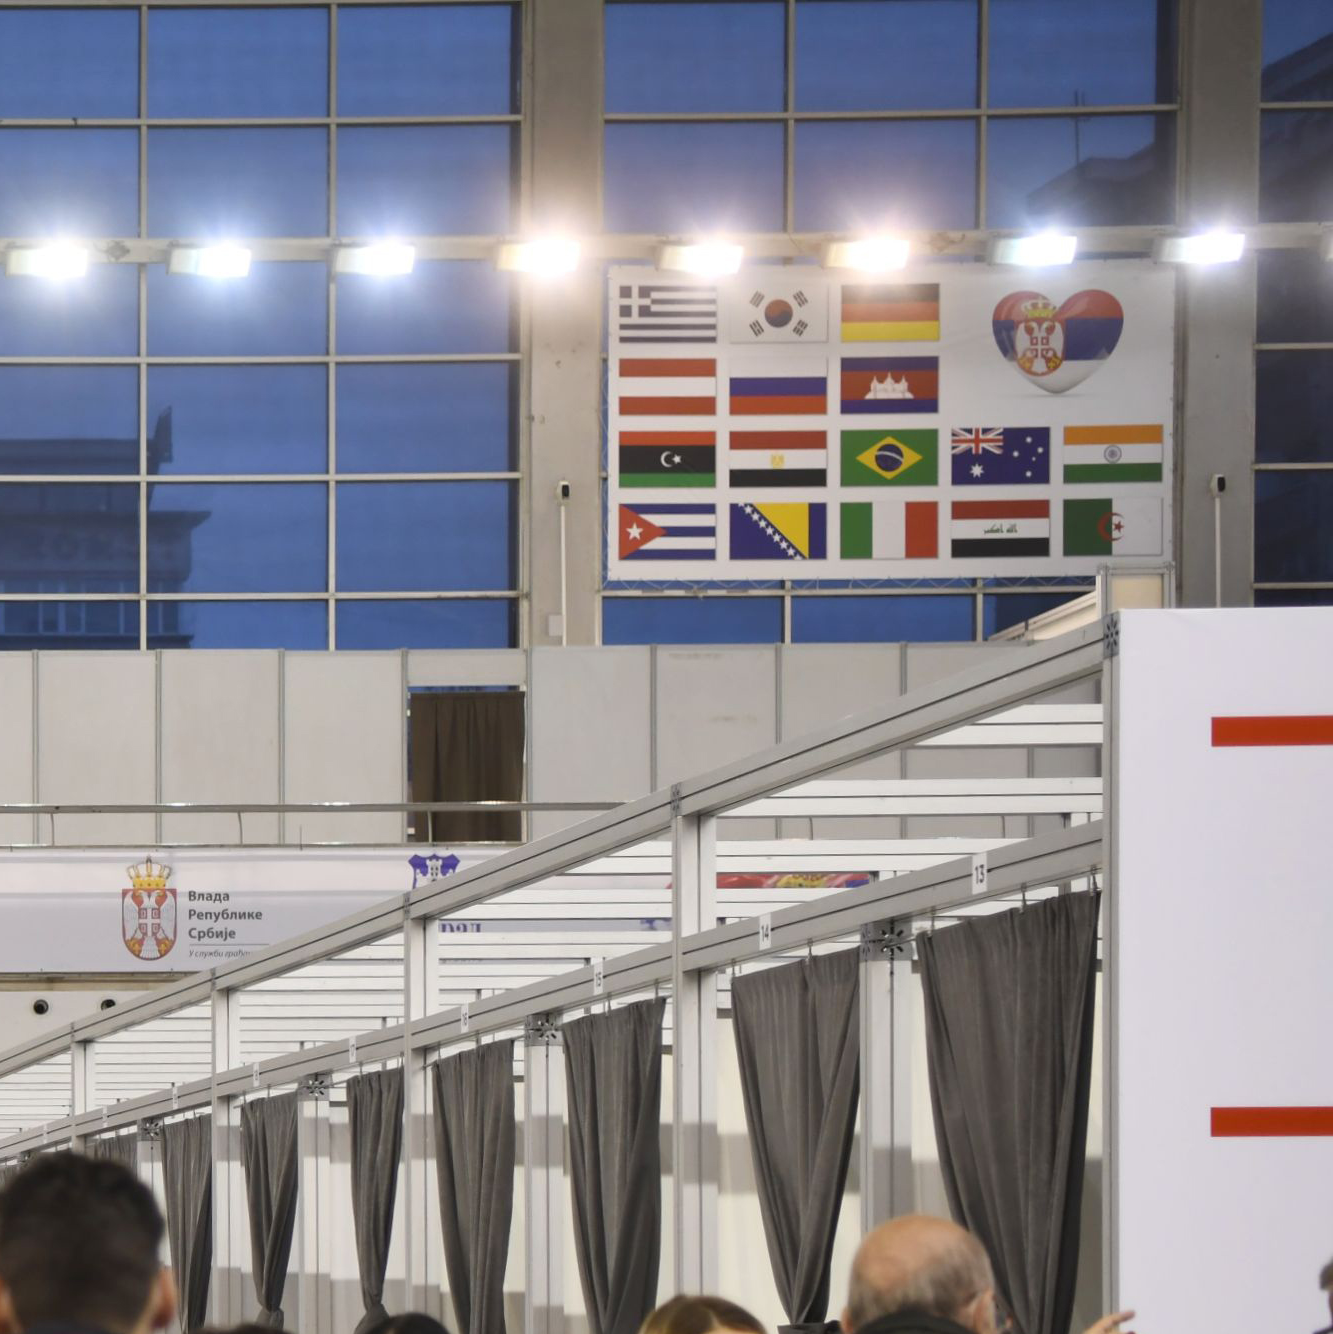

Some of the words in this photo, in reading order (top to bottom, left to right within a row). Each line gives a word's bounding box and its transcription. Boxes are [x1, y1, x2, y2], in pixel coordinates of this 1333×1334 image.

[974, 864, 986, 885] 13
[188, 890, 231, 903] Влада
[188, 908, 264, 923] Републике
[188, 927, 237, 941] Србије
[761, 924, 770, 942] 14
[195, 949, 223, 958] служби
